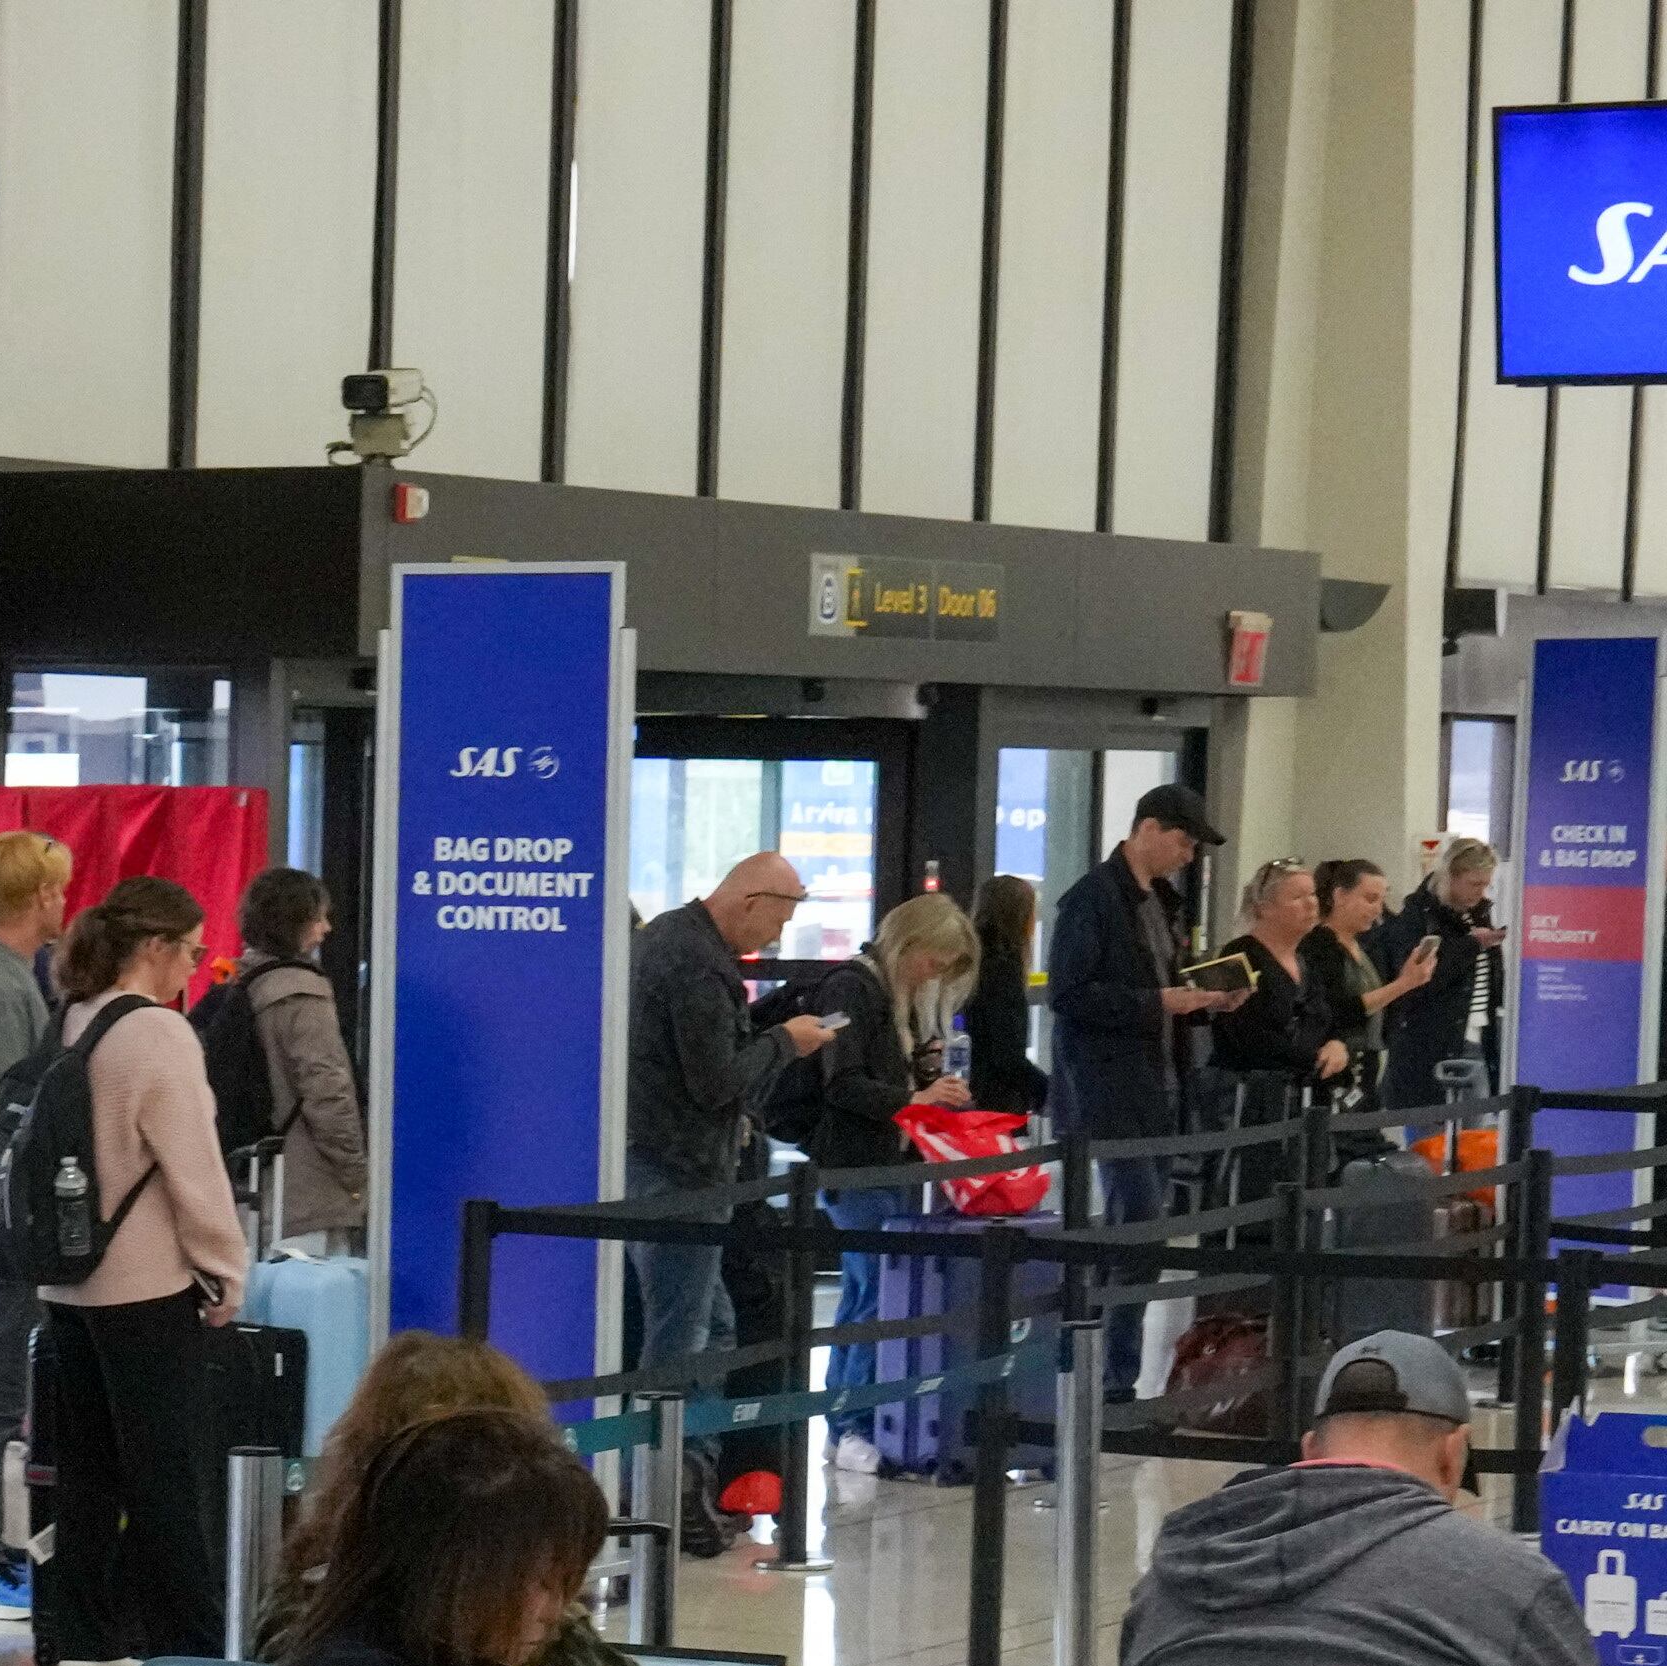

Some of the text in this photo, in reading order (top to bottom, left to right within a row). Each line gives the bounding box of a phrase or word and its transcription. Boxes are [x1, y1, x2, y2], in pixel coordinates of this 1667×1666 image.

[874, 582, 929, 614] Level 3
[938, 585, 975, 617] Door
[449, 746, 523, 778] SAS
[1559, 760, 1603, 782] SAS
[1551, 825, 1627, 843] CHECK IN
[433, 836, 574, 863] BAG DROP
[1539, 849, 1638, 868] & BAG DROP
[412, 870, 595, 897] & DOCUMENT
[436, 904, 567, 932] CONTROL
[1621, 1492, 1667, 1510] SAS
[1555, 1518, 1616, 1536] CARRY
[1617, 1521, 1647, 1538] ON
